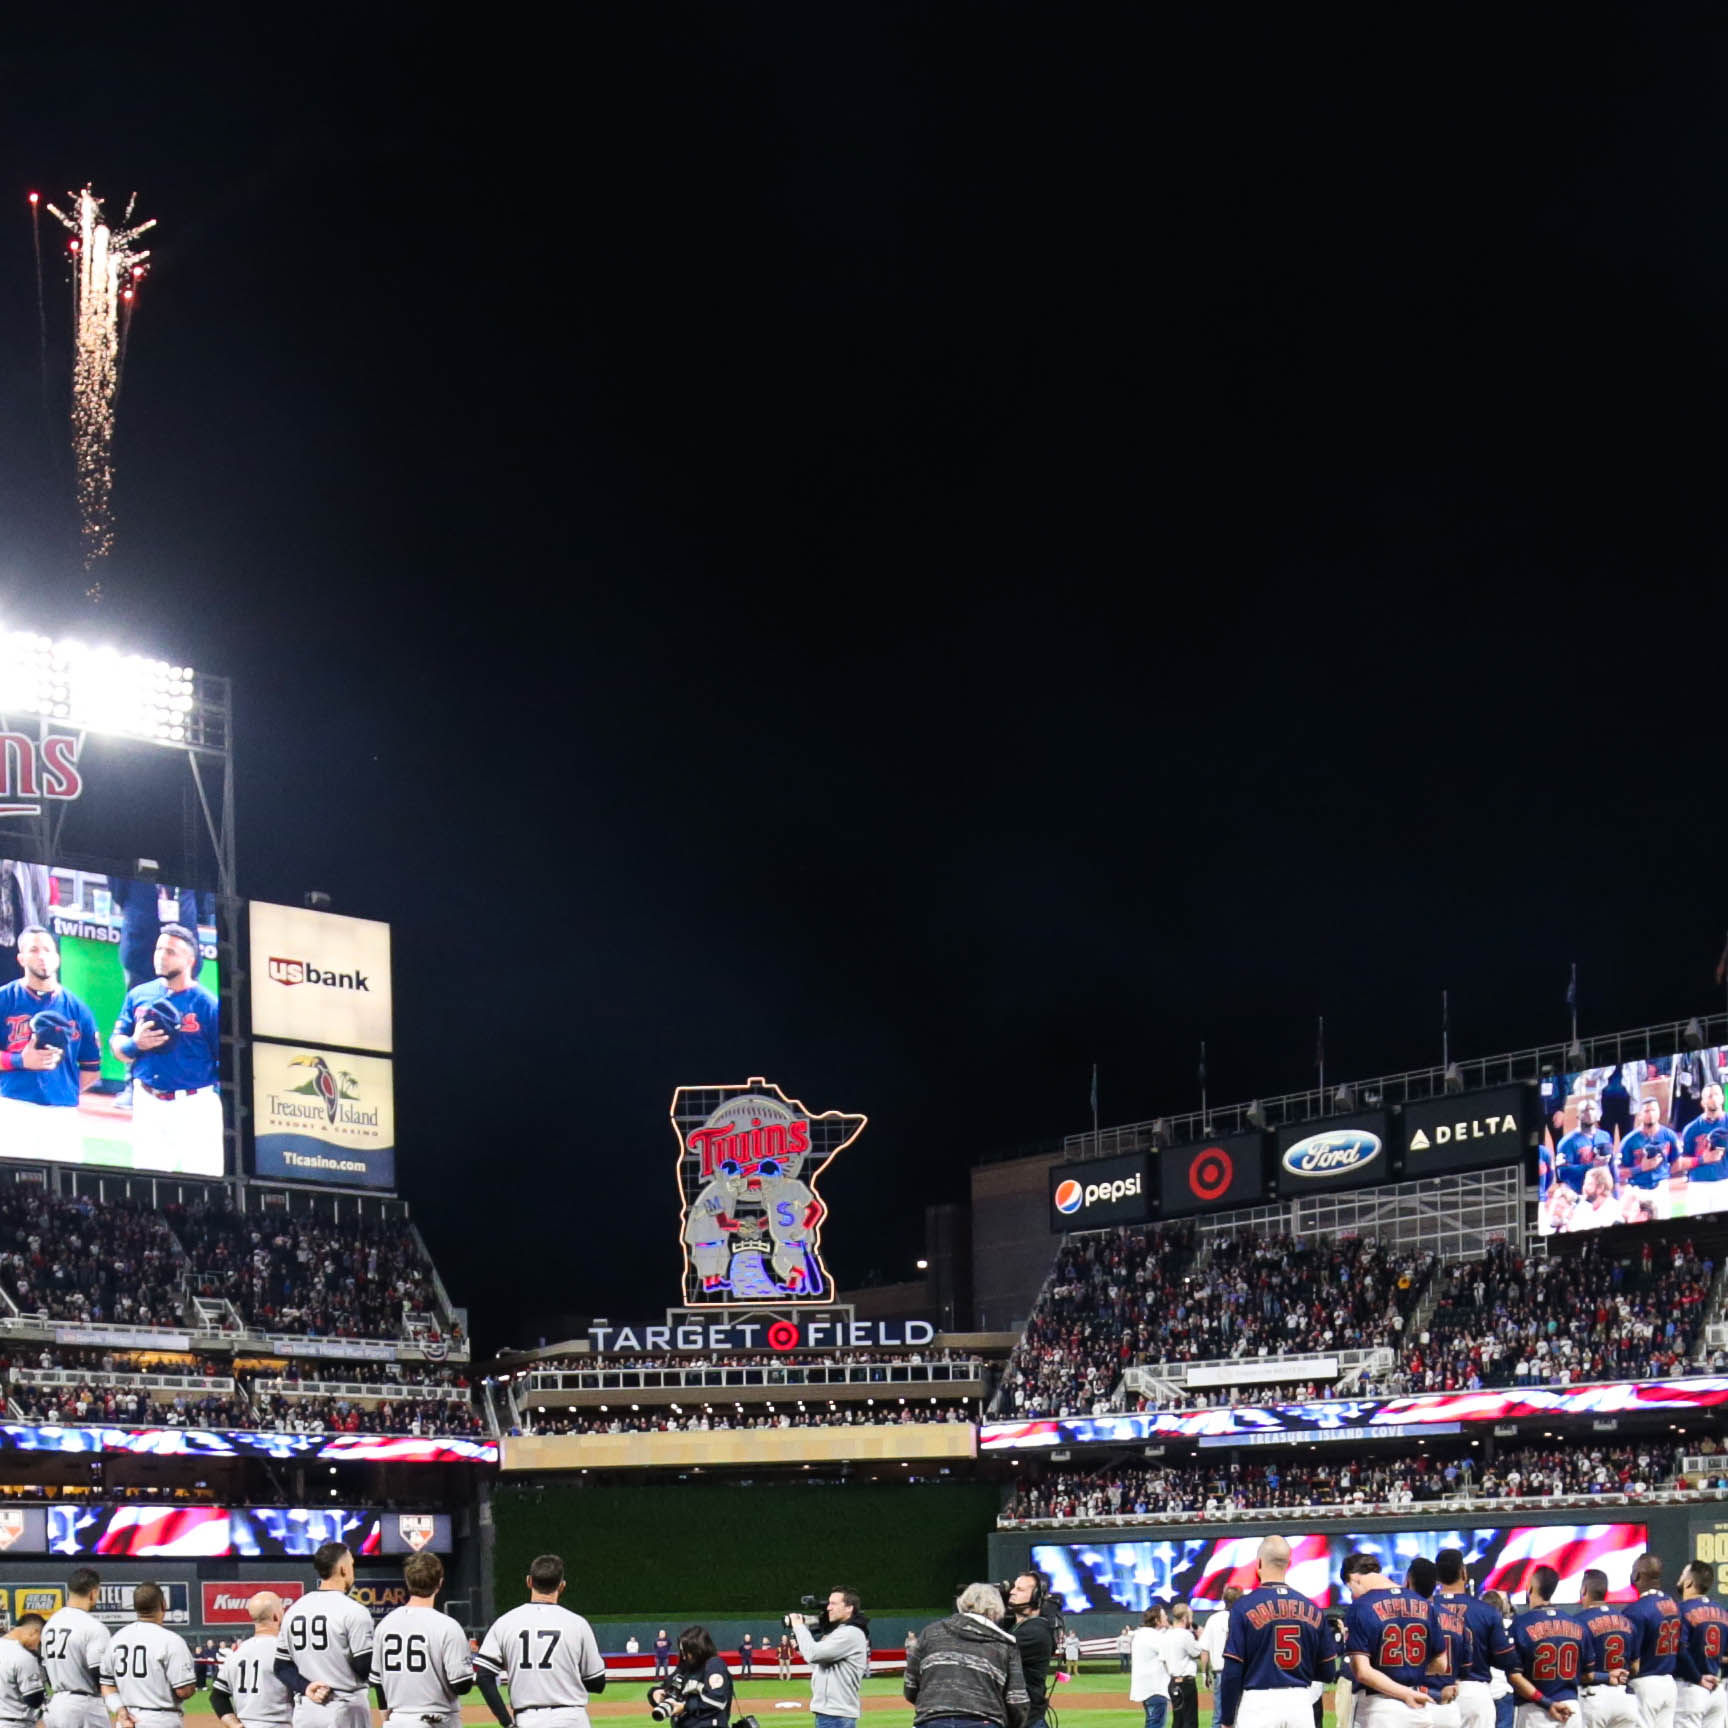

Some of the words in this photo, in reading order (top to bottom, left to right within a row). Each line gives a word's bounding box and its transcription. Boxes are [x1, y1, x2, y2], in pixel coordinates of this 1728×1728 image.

[267, 1094, 325, 1121] Treasure
[340, 1103, 379, 1127] Island
[1434, 1114, 1517, 1146] DELTA
[283, 1152, 367, 1173] TIcasino.com
[687, 1119, 812, 1178] Twins
[1300, 1138, 1361, 1172] Ford
[1085, 1172, 1142, 1208] pepsi
[589, 1324, 761, 1352] TARGET
[808, 1320, 935, 1348] FIELD
[1248, 1430, 1311, 1445] TREASURE
[1318, 1427, 1364, 1441] ISLAND
[1371, 1425, 1405, 1438] COVE
[1245, 1599, 1323, 1630] BALDELLI
[1372, 1598, 1428, 1622] KEPLER
[45, 1627, 73, 1661] 27
[290, 1614, 329, 1652] 99
[517, 1629, 562, 1671] 17
[1273, 1624, 1301, 1670] 5
[1379, 1623, 1428, 1667] 26
[1704, 1624, 1721, 1659] 9
[114, 1644, 148, 1680] 30
[384, 1634, 427, 1673] 26
[1533, 1641, 1579, 1681] 20
[1604, 1634, 1626, 1672] 2
[237, 1659, 260, 1695] 11
